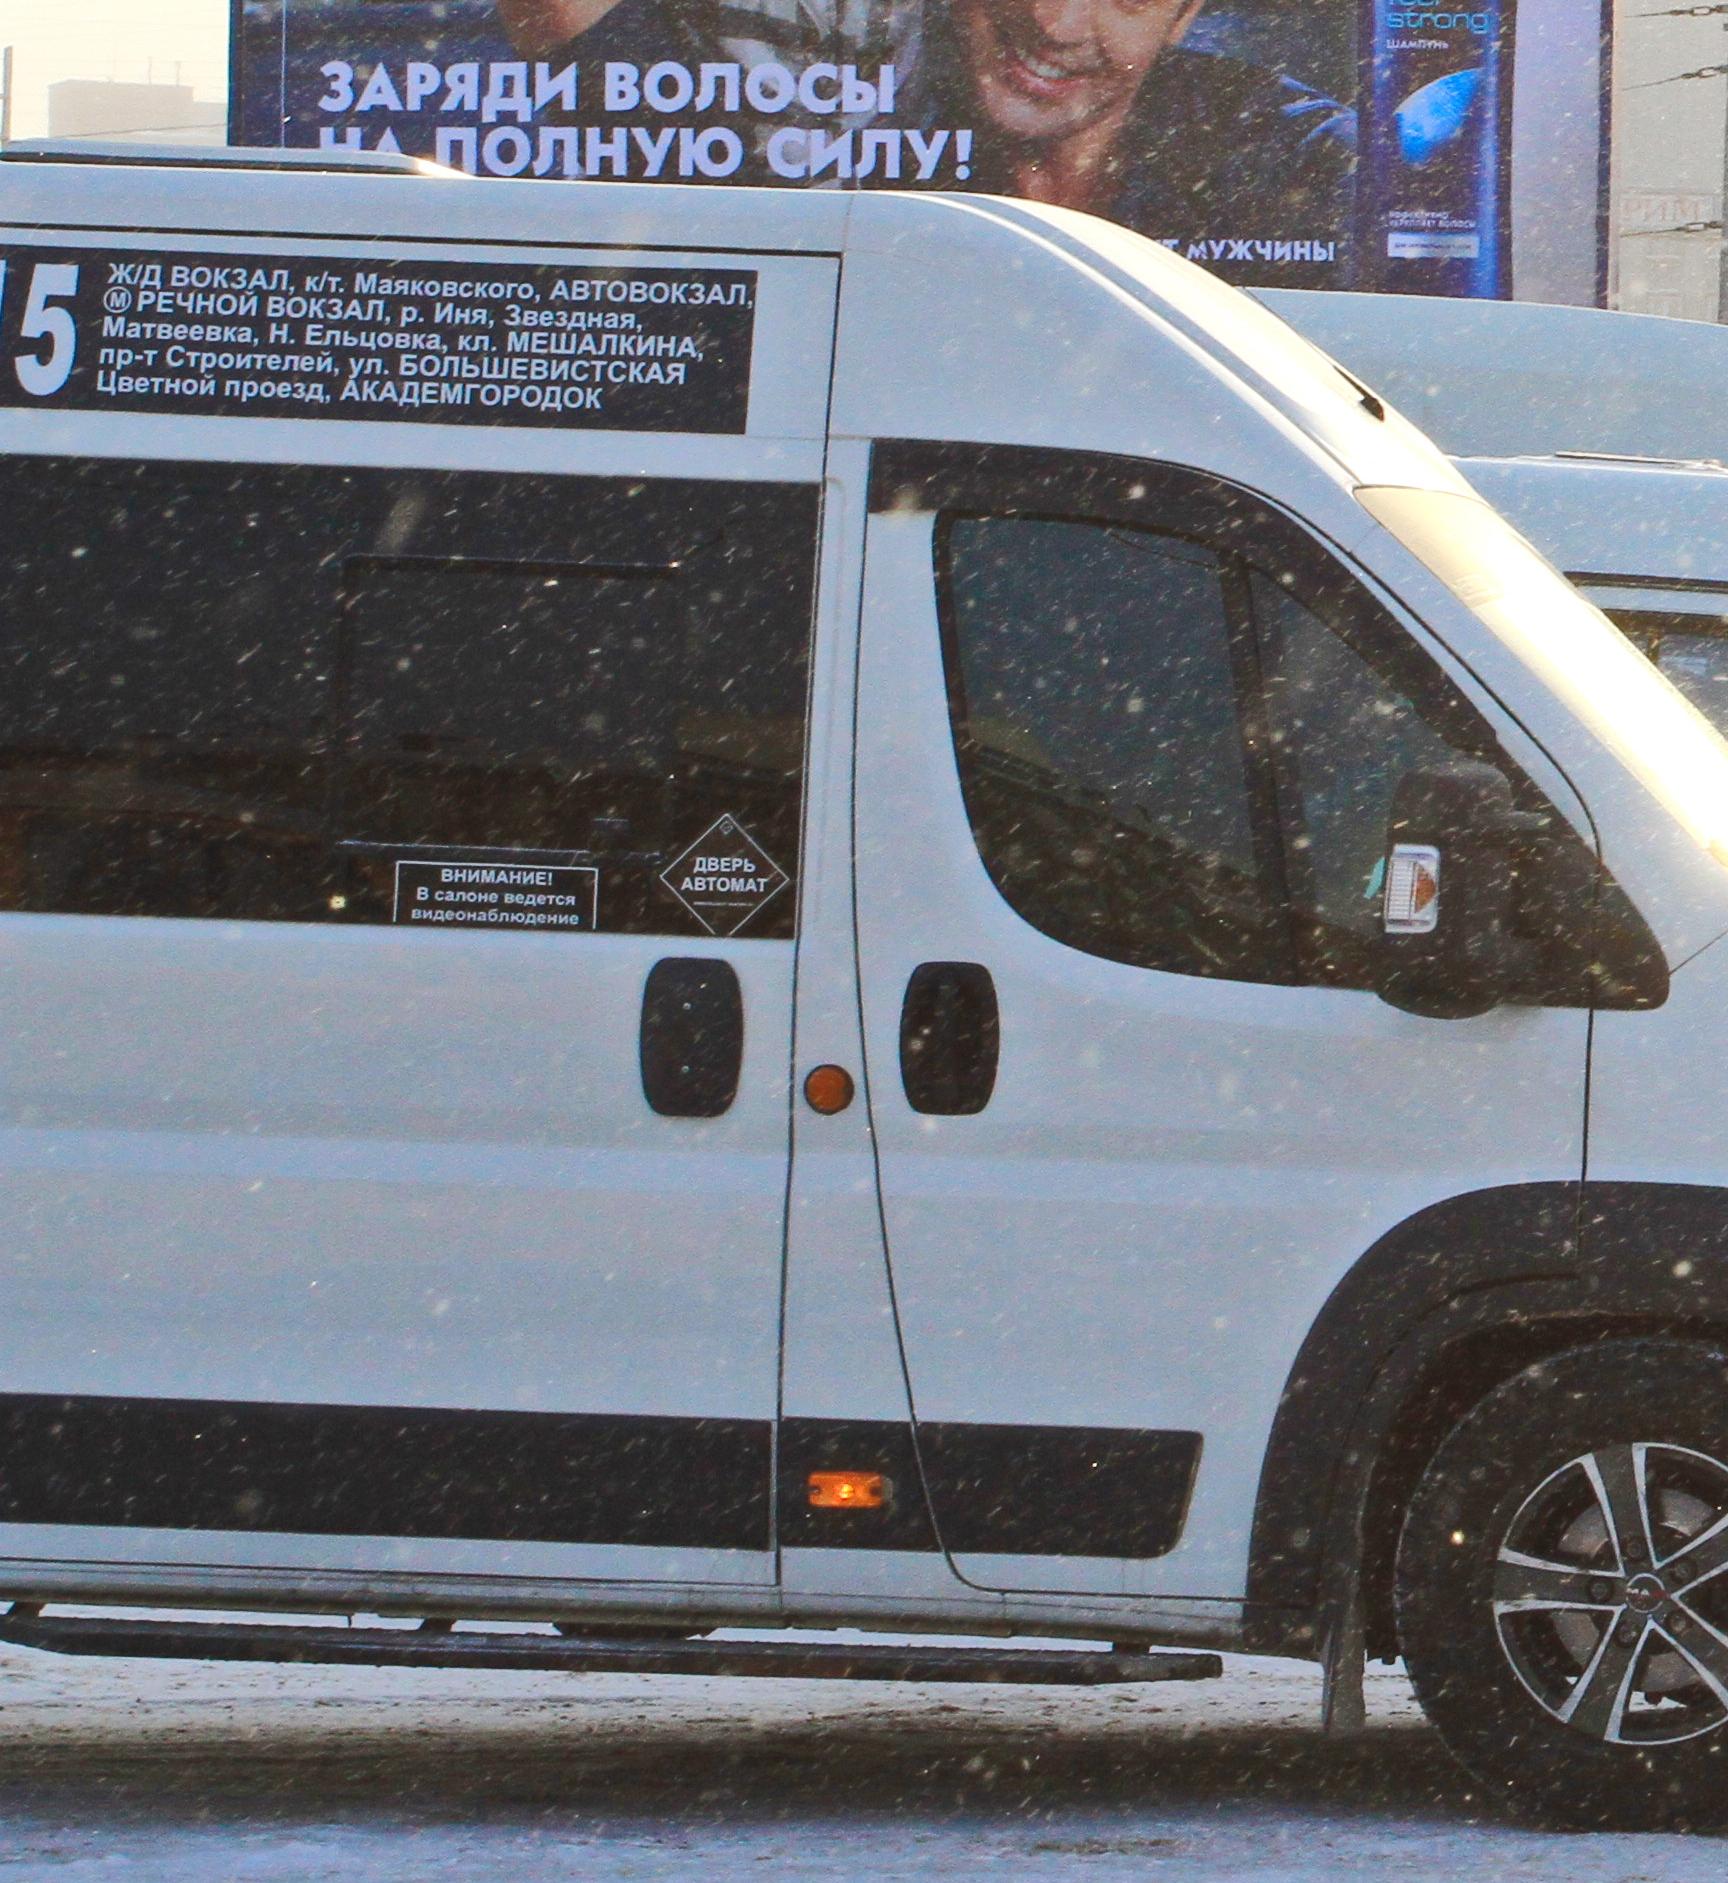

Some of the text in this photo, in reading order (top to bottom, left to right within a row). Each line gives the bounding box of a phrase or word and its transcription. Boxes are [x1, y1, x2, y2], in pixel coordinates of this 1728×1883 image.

[1386, 12, 1489, 35] strong
[318, 60, 896, 123] ЗАРЯДИ ВОЛОСЫ
[435, 125, 744, 178] ПОЛНУЮ
[766, 127, 973, 180] СИЛУ!
[1186, 238, 1335, 262] МУЖЧИНЫ
[107, 262, 754, 308] Ж/Д ВОКЗАЛ, к/т. Маяковского, АВТОВОКЗАЛ,
[0, 259, 79, 396] 5
[136, 290, 258, 317] РЕЧНОЙ
[266, 296, 391, 325] ВОКЗАЛ,
[400, 304, 425, 328] р.
[433, 303, 495, 328] Иня,
[504, 304, 643, 332] Звездная,
[102, 316, 705, 363] Матвеевка, Н. Ельцовка, кл. МЕШАЛКИНА,
[98, 345, 686, 385] пр-т Строителей, ул. БОЛЬШЕВИСТСКАЯ
[96, 370, 602, 412] Цветной проезд, АКАДЕМГОРОДОК
[441, 868, 553, 886] ВНИМАНИЕ!
[680, 876, 769, 893] АВТОМАТ
[693, 856, 757, 874] ДВЕРЬ
[416, 886, 576, 906] В салоне ведется
[411, 908, 579, 926] видеонаблюдение
